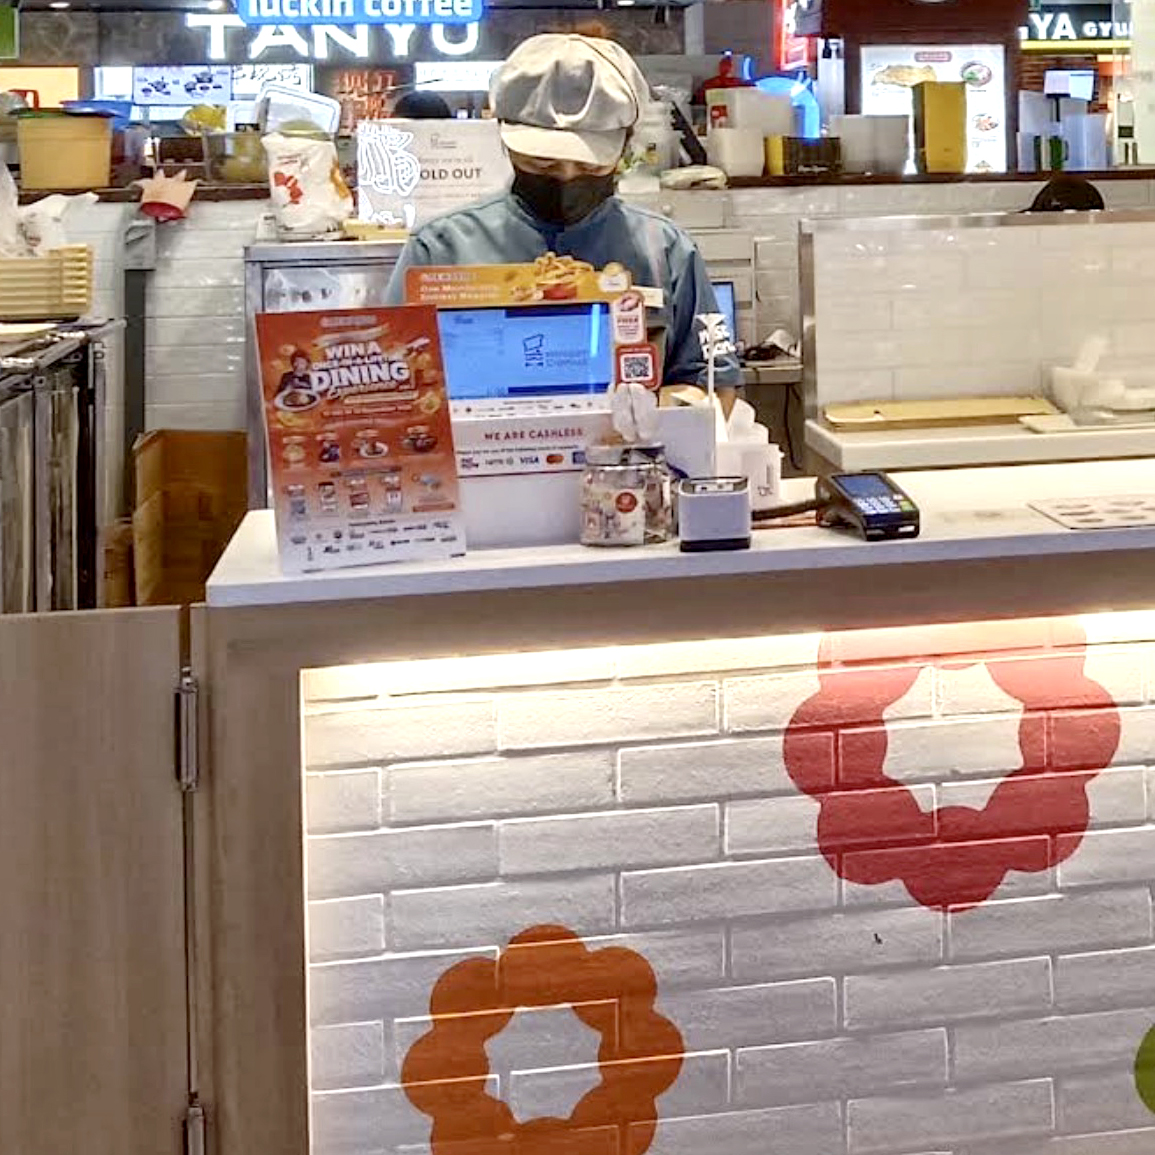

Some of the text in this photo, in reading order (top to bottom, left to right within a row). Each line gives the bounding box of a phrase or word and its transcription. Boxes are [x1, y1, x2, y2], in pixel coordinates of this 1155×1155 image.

[419, 167, 482, 181] OLD OUT
[325, 340, 382, 359] WIN A
[310, 362, 411, 392] DINING
[504, 430, 525, 440] ARE
[528, 427, 583, 439] CASHLESS
